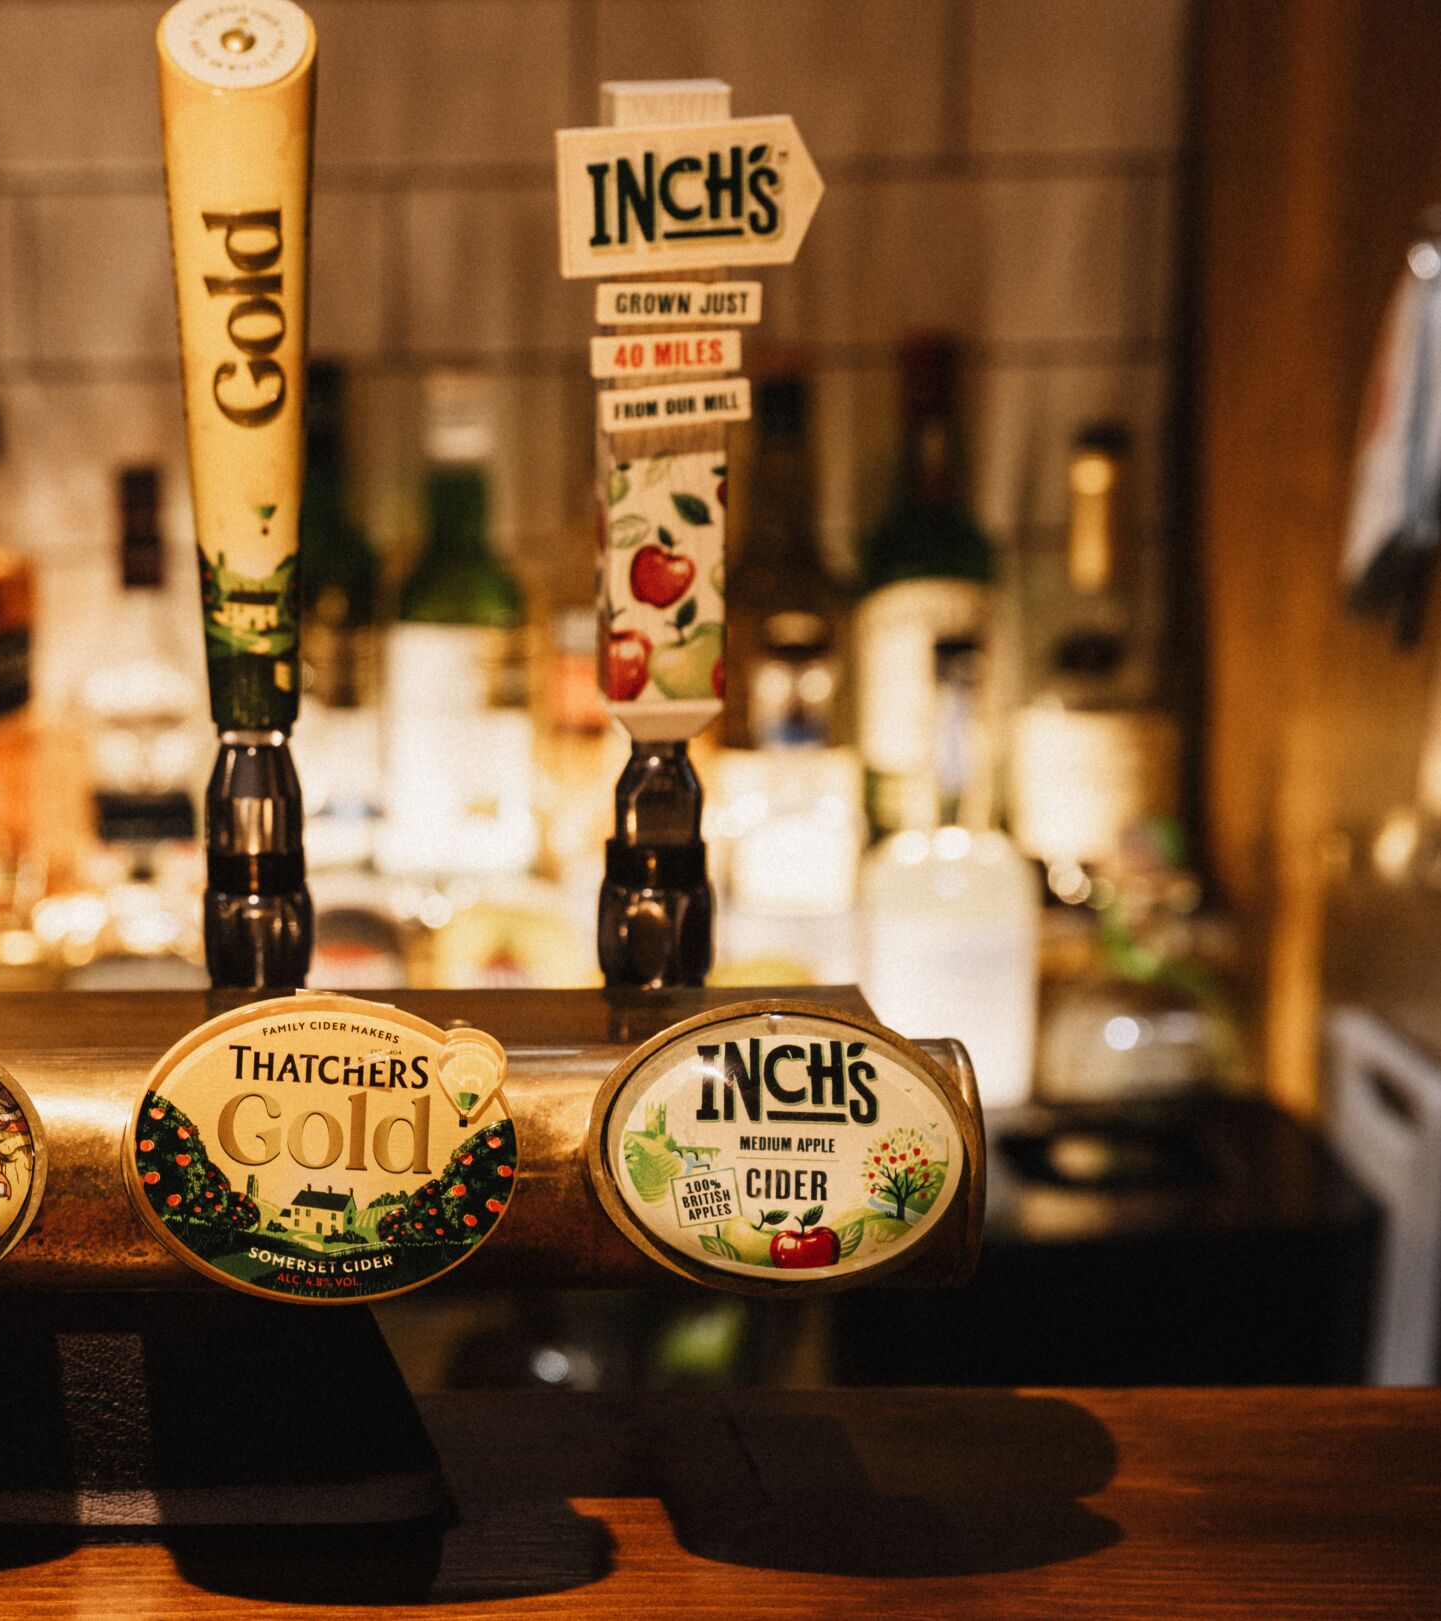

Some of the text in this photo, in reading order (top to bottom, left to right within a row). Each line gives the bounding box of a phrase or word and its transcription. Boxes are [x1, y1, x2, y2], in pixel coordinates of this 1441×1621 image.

[587, 144, 780, 247] INCH'S
[615, 292, 749, 315] GROWN JUST
[202, 209, 286, 428] Gold
[614, 339, 724, 369] 40 MILES
[614, 393, 739, 420] FROM OUR MILL
[262, 1021, 400, 1044] FAMILY CIDER MAKERS
[228, 1045, 429, 1090] THATCHERS
[695, 1038, 879, 1125] INCH'S
[217, 1091, 432, 1175] Gold
[739, 1136, 835, 1153] MEDIUM APPLE
[685, 1178, 722, 1195] 100%
[746, 1168, 828, 1201] CIDER
[681, 1189, 731, 1209] BRITISH
[688, 1203, 732, 1221] APPLES
[248, 1247, 394, 1274] SOMERSET CIDER
